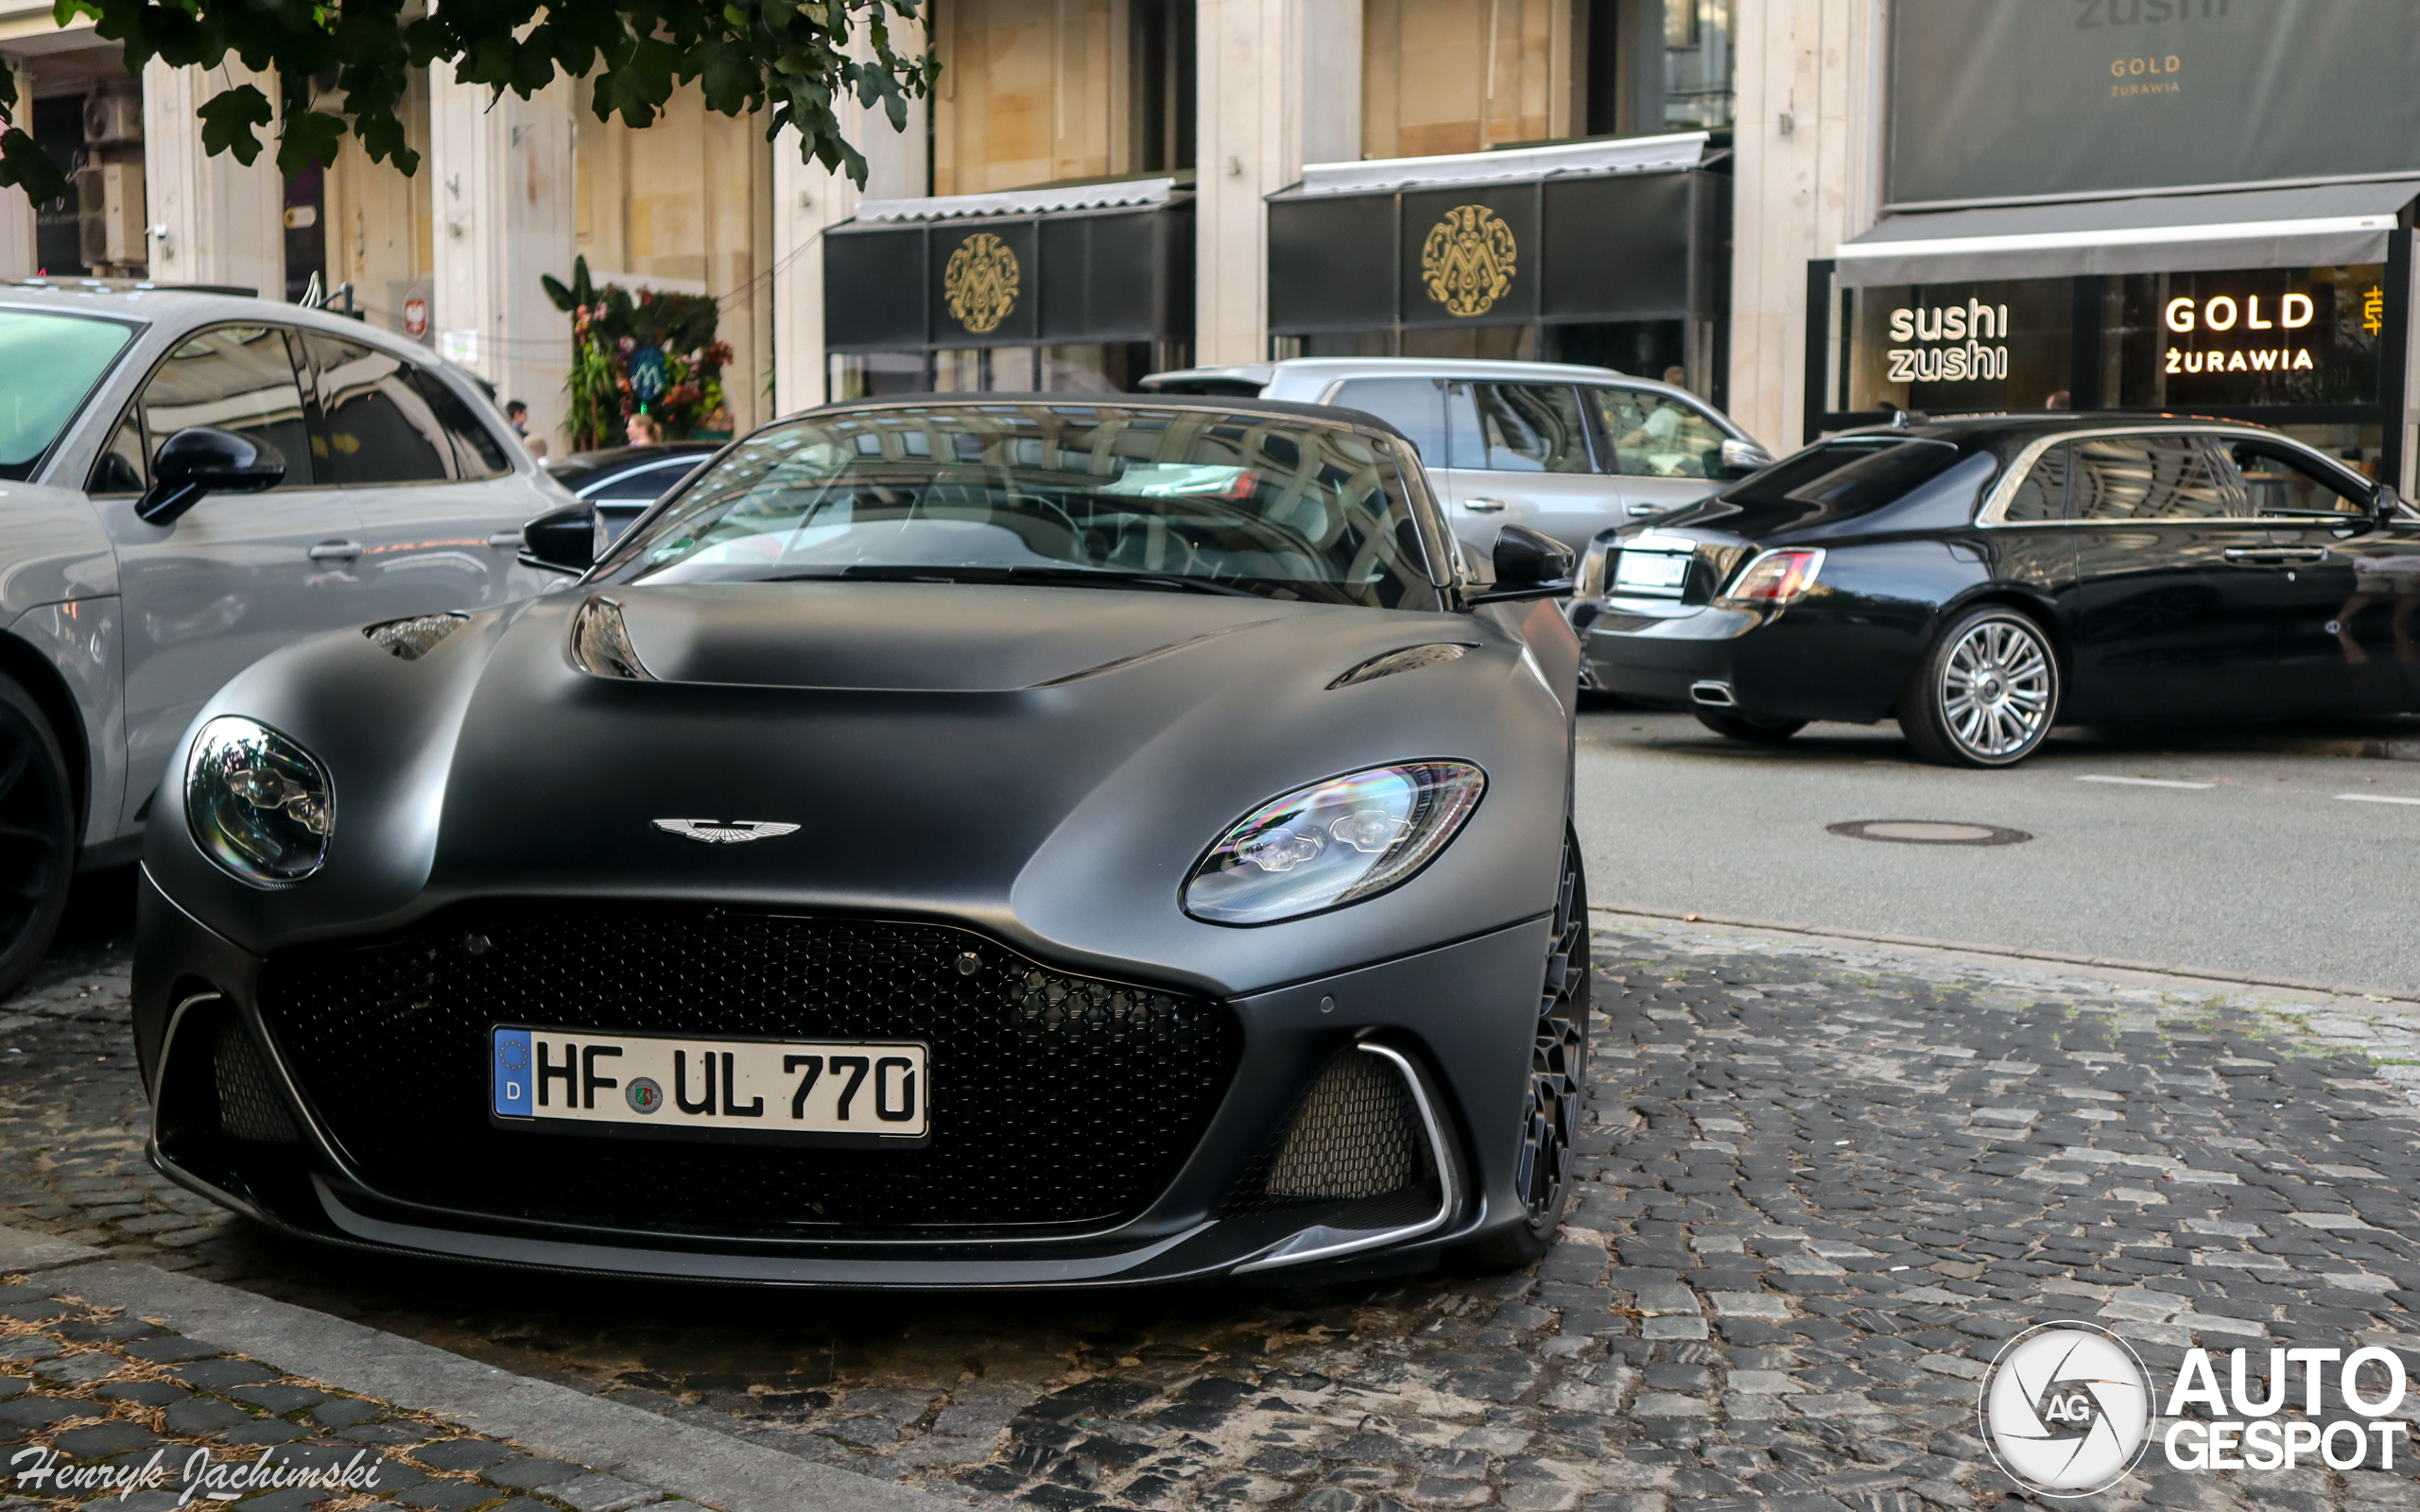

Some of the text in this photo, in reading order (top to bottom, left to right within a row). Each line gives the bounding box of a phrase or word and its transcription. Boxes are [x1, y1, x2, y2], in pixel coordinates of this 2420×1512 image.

[2110, 55, 2182, 77] GOLD
[1889, 297, 2008, 341] sushi
[2165, 293, 2314, 333] GOLD
[1887, 338, 2008, 382] zushi
[2165, 347, 2314, 374] ŻURAWIA
[507, 1081, 522, 1101] D
[537, 1041, 624, 1109] HF
[674, 1049, 764, 1117] UL
[783, 1054, 917, 1123] 770
